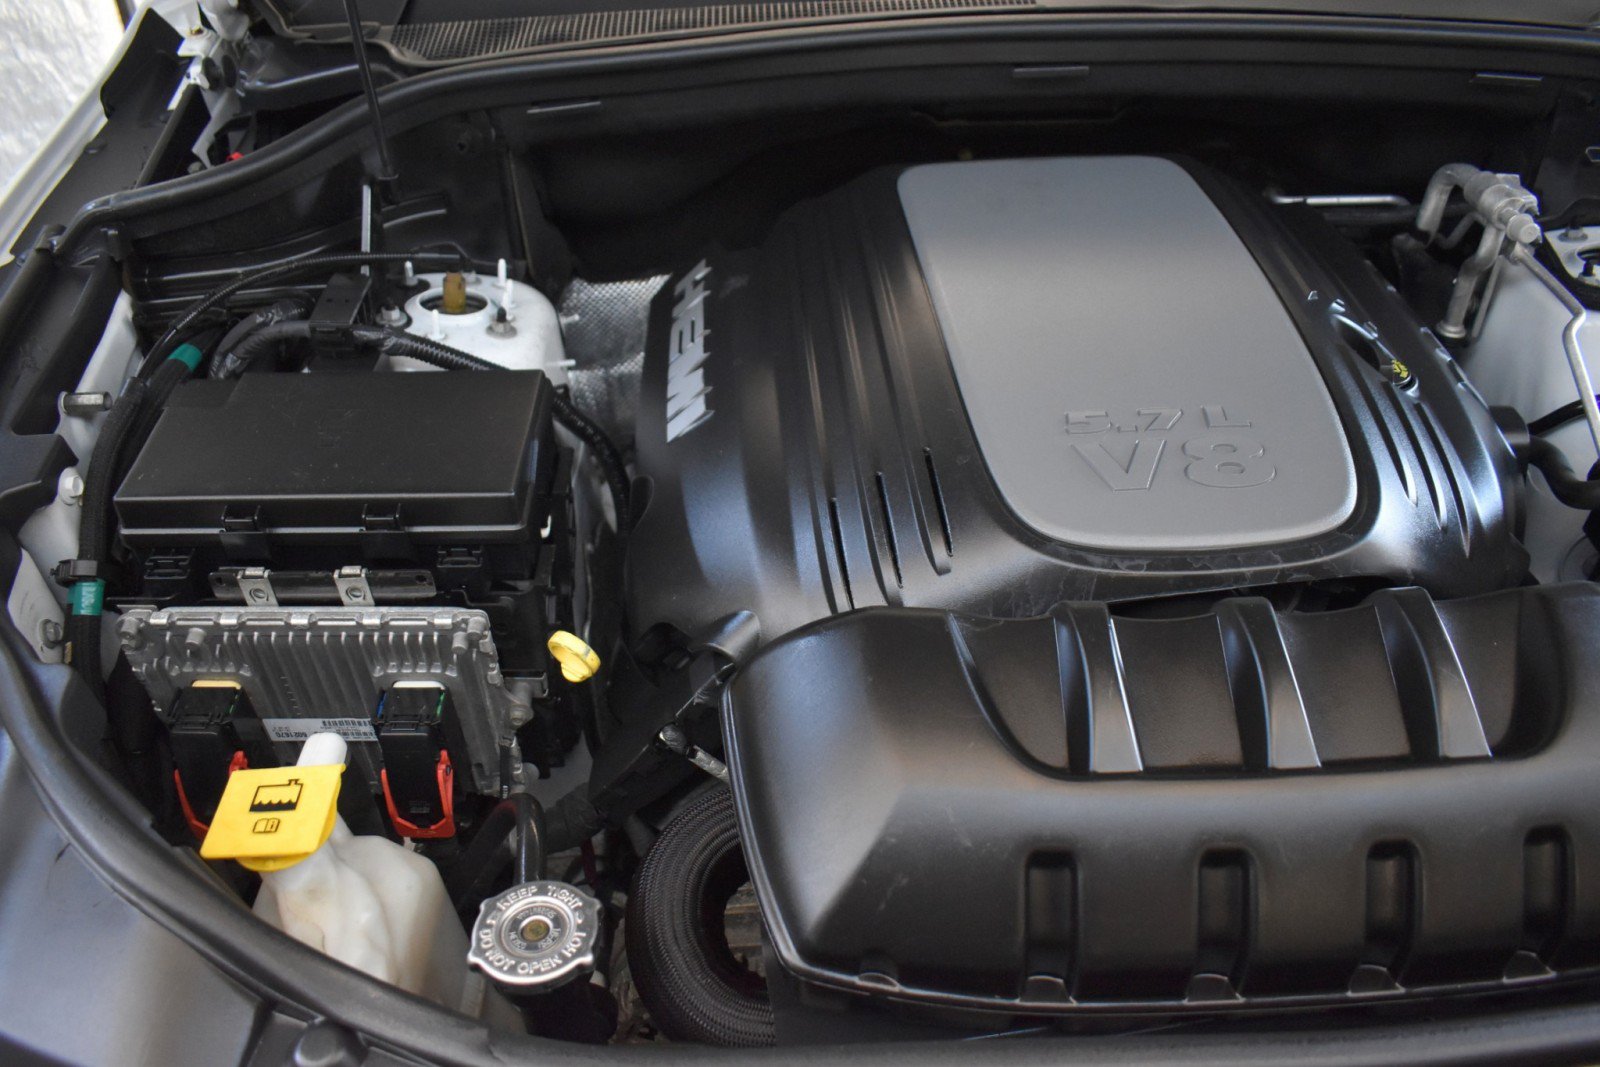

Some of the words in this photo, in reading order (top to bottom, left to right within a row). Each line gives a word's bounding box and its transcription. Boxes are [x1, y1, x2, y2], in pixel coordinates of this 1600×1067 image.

[665, 258, 715, 443] HEMI
[1069, 438, 1276, 492] V8
[496, 885, 538, 911] KEEP
[547, 885, 583, 909] TIGHT
[479, 929, 494, 949] DO
[561, 932, 587, 958] HOT
[485, 949, 516, 971] NOT
[517, 955, 563, 974] OPEN
